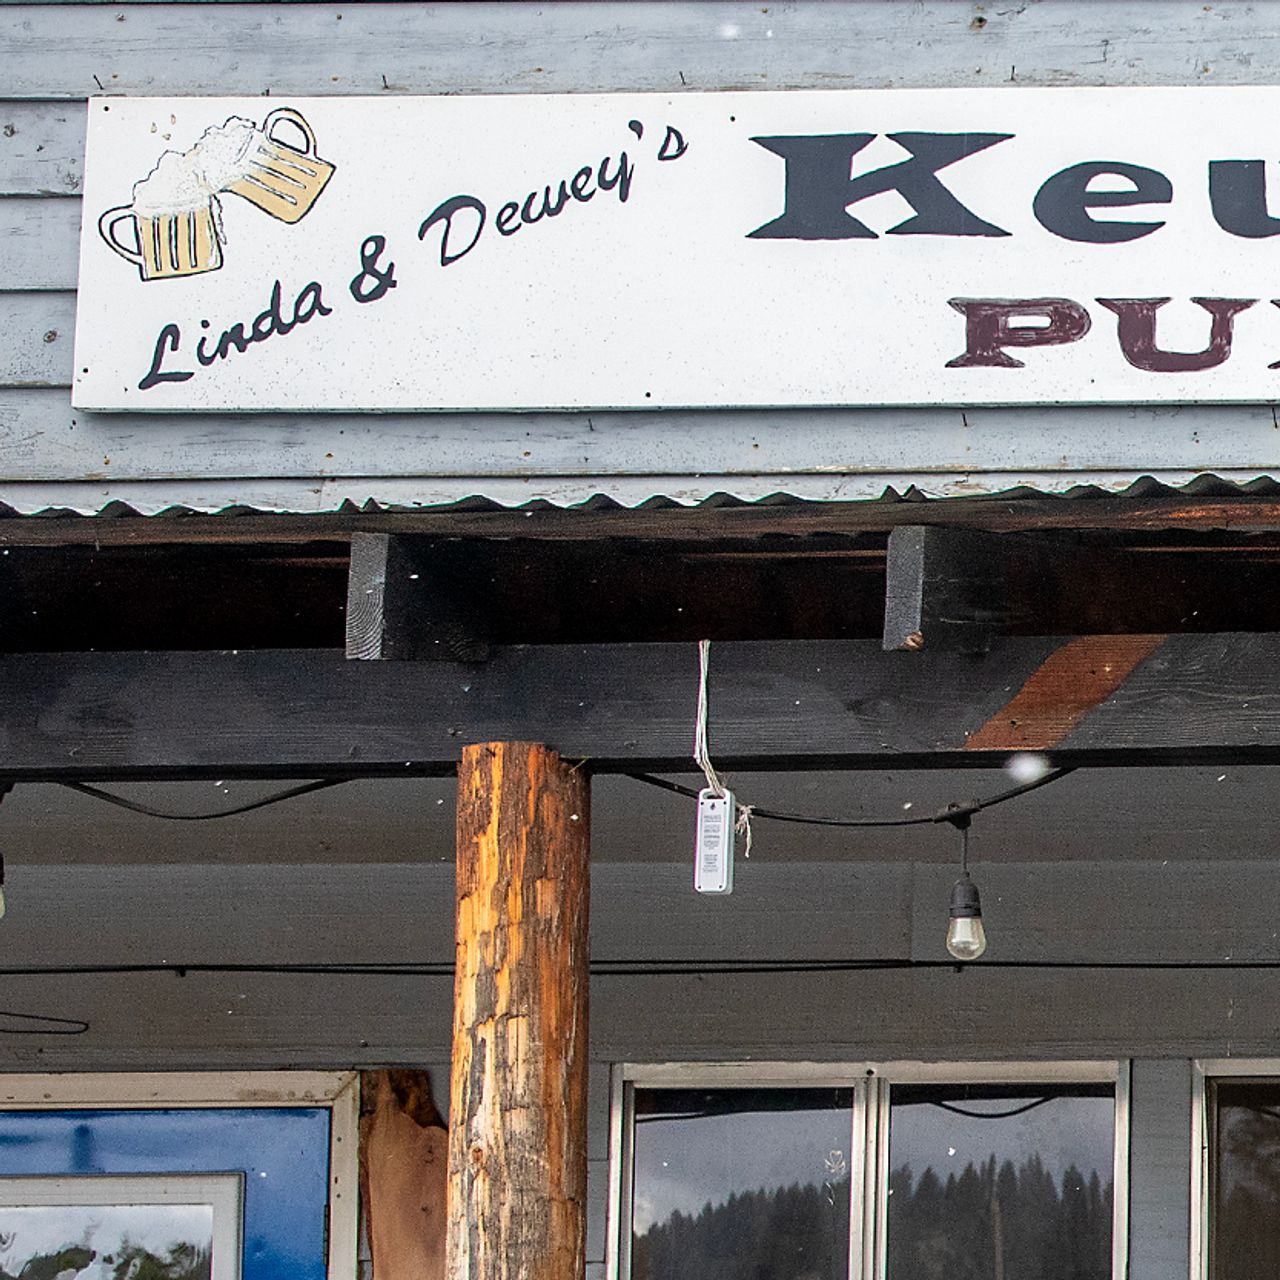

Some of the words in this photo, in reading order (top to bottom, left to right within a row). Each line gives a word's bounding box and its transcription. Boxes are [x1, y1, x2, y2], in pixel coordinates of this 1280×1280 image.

[138, 280, 332, 390] Linda
[350, 236, 397, 303] &
[418, 120, 688, 266] Dewey's
